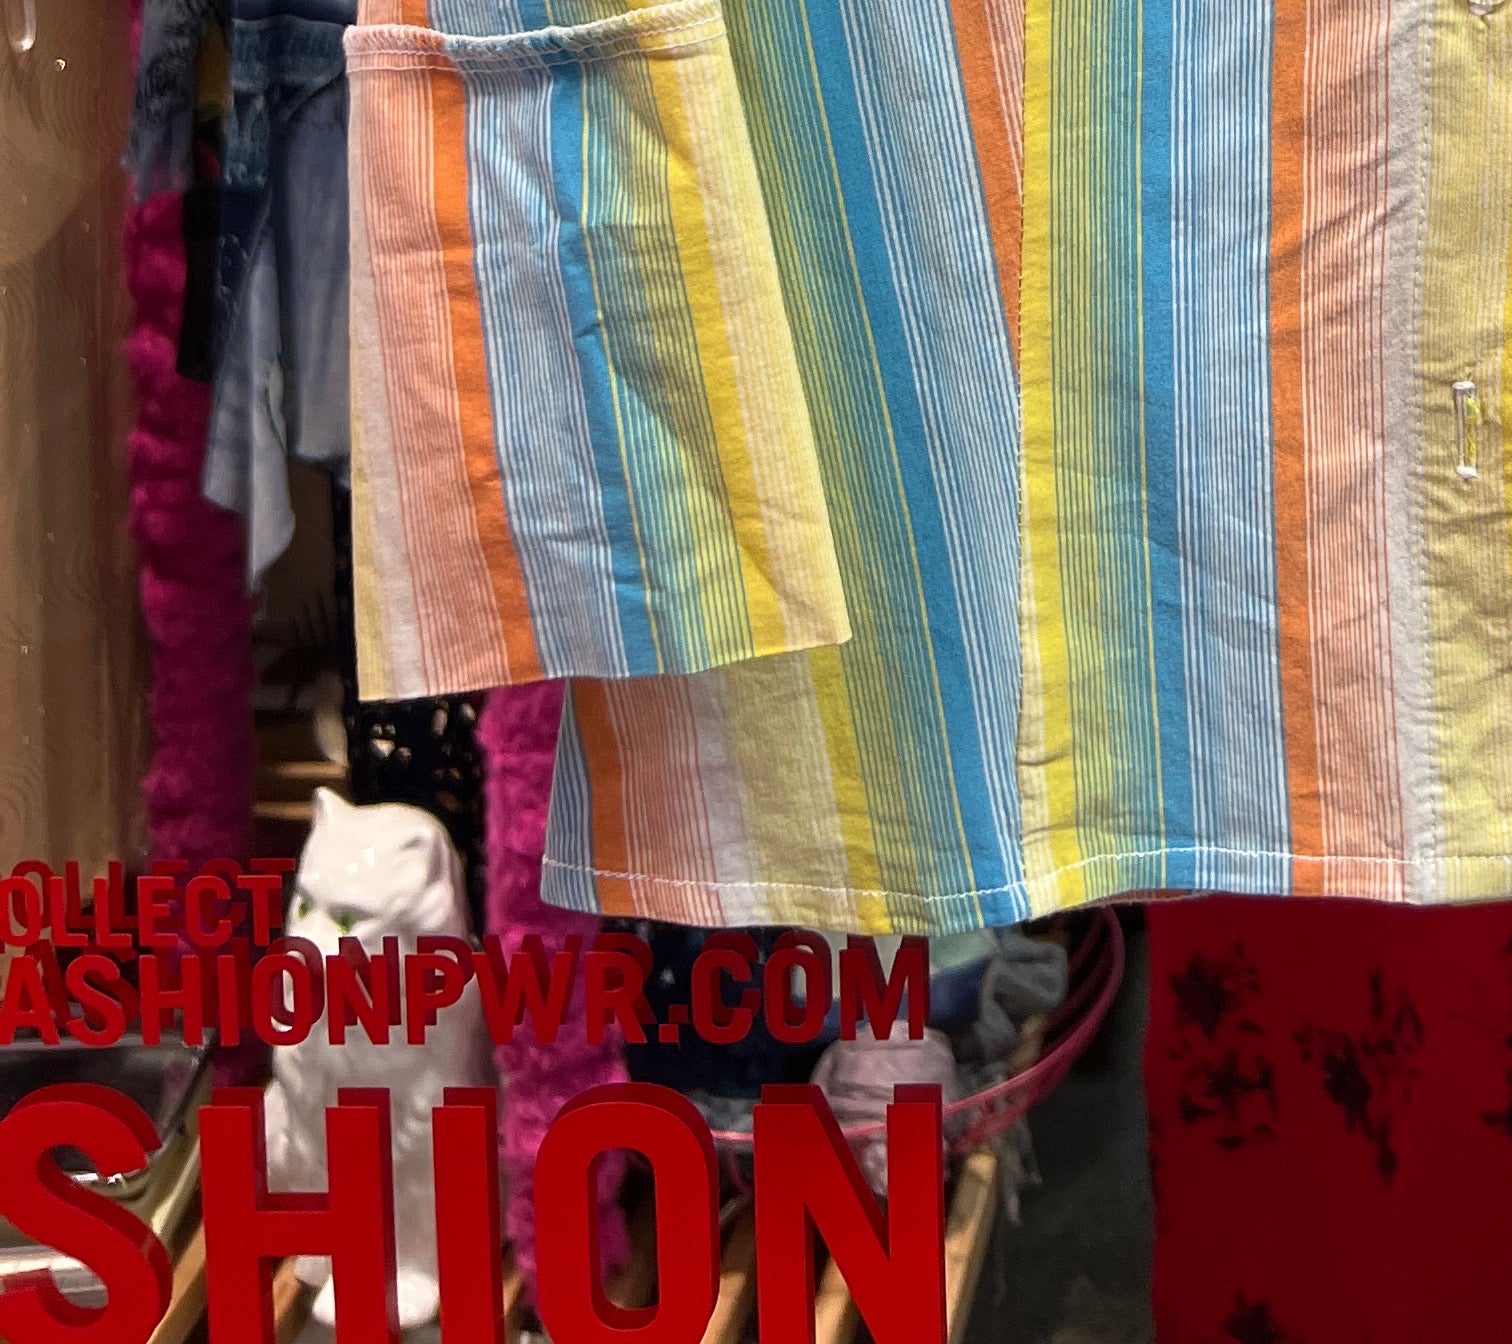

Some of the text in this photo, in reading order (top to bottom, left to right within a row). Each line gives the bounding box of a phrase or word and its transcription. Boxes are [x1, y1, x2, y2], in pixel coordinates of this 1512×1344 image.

[0, 875, 282, 947] OLLECT
[0, 948, 924, 1047] ASHIONPWR.COM
[0, 1101, 942, 1344] SHION
